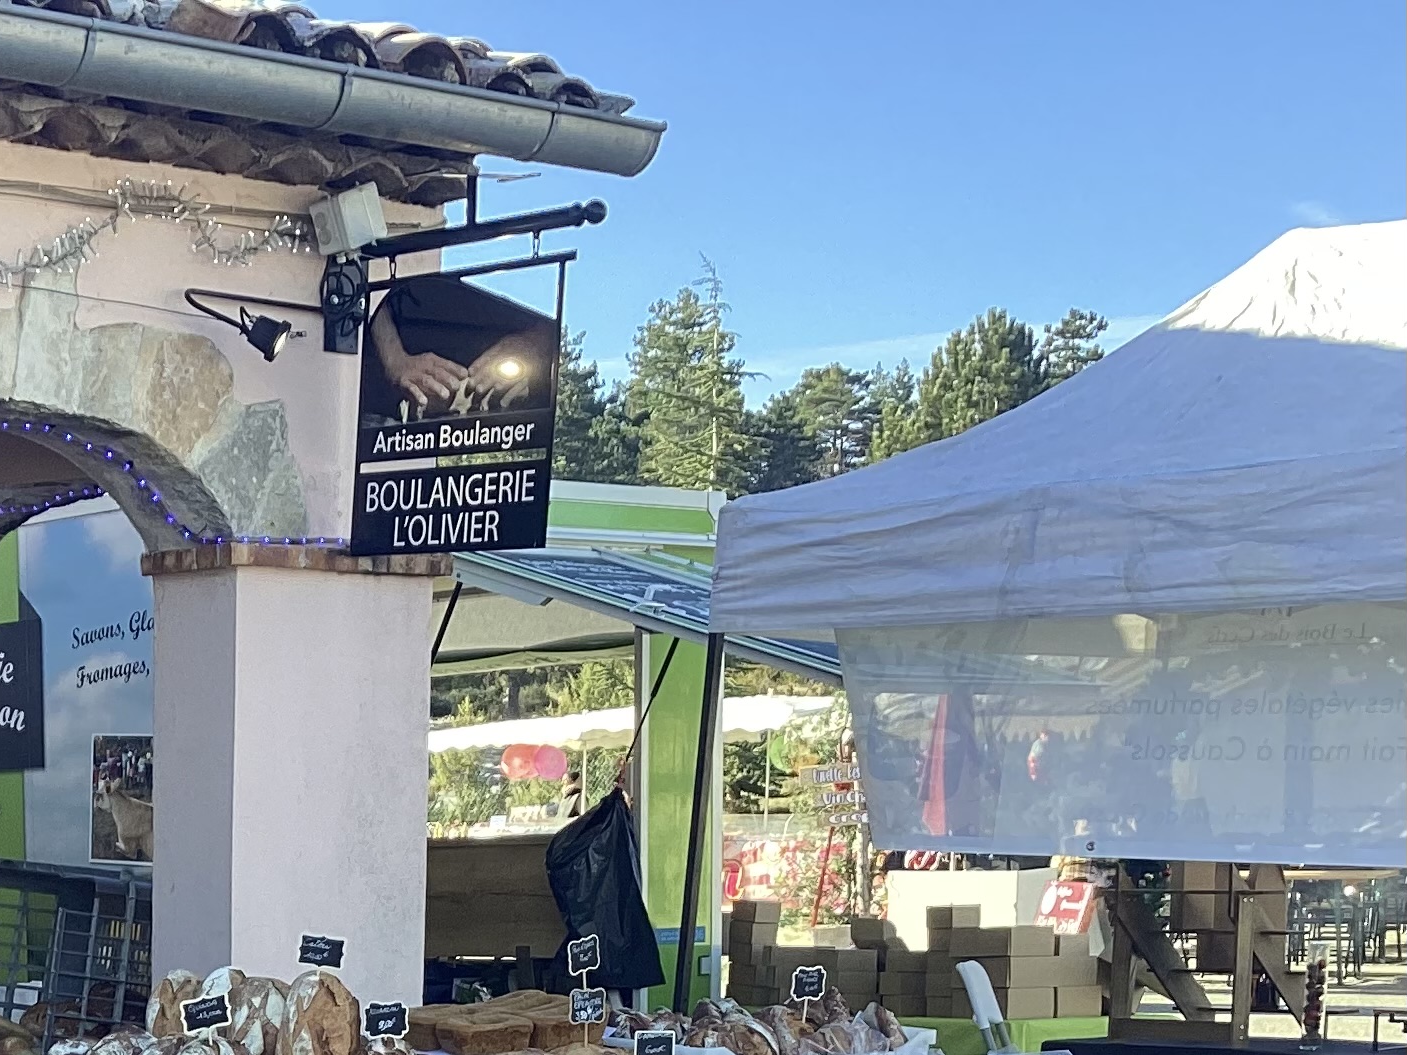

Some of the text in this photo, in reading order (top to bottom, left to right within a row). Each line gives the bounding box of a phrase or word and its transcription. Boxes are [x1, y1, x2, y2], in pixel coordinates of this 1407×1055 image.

[373, 421, 534, 454] Artisan Boulanger
[366, 470, 535, 512] BOULANGERIE
[394, 511, 500, 547] L'OLIVIER
[71, 622, 125, 650] Savons,
[76, 660, 150, 688] Fromages,
